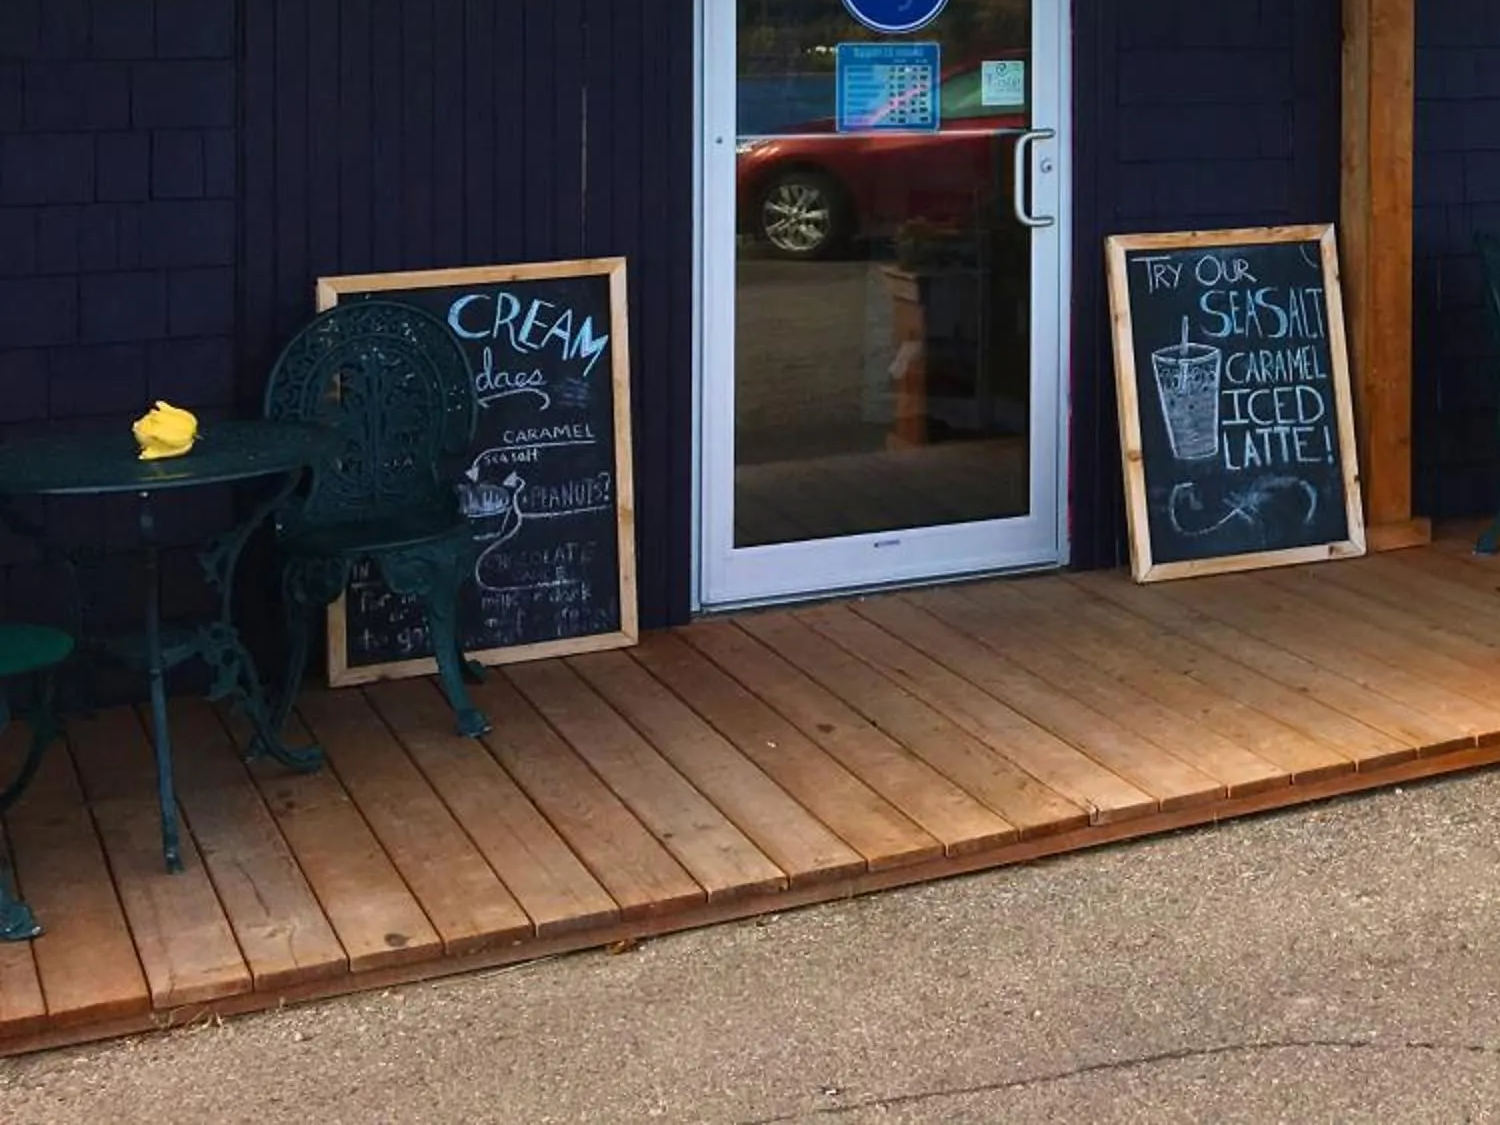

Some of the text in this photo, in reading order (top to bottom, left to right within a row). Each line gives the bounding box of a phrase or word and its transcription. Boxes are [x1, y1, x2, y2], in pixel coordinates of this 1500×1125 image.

[1132, 254, 1258, 294] TRY OUR
[447, 291, 609, 377] CREAM
[1225, 344, 1327, 384] CARAMEL
[1221, 386, 1325, 426] ICED
[503, 424, 595, 444] CARAMEL
[1224, 426, 1335, 470] LATTE!
